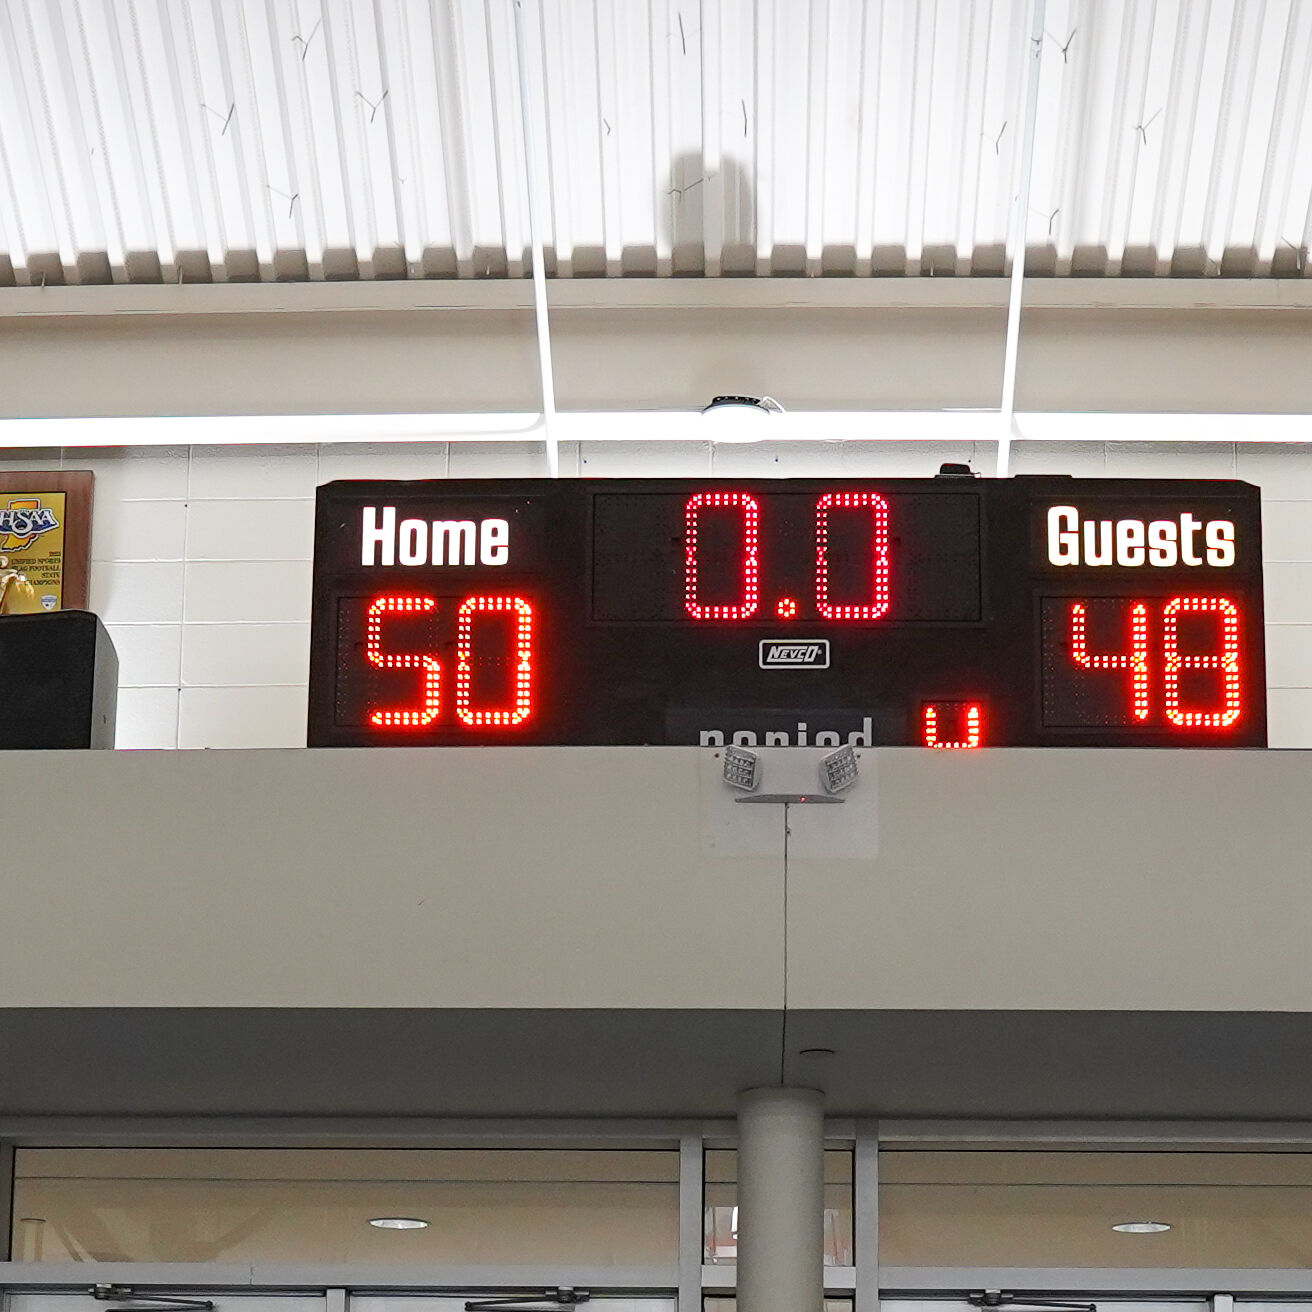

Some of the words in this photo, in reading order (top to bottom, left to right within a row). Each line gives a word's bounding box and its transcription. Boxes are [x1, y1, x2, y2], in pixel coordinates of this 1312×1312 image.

[360, 506, 510, 567] Home
[685, 491, 890, 621] 0.0
[1046, 505, 1236, 568] Guests
[366, 596, 532, 726] 50
[766, 645, 820, 663] NEVCO
[1070, 596, 1240, 728] 48
